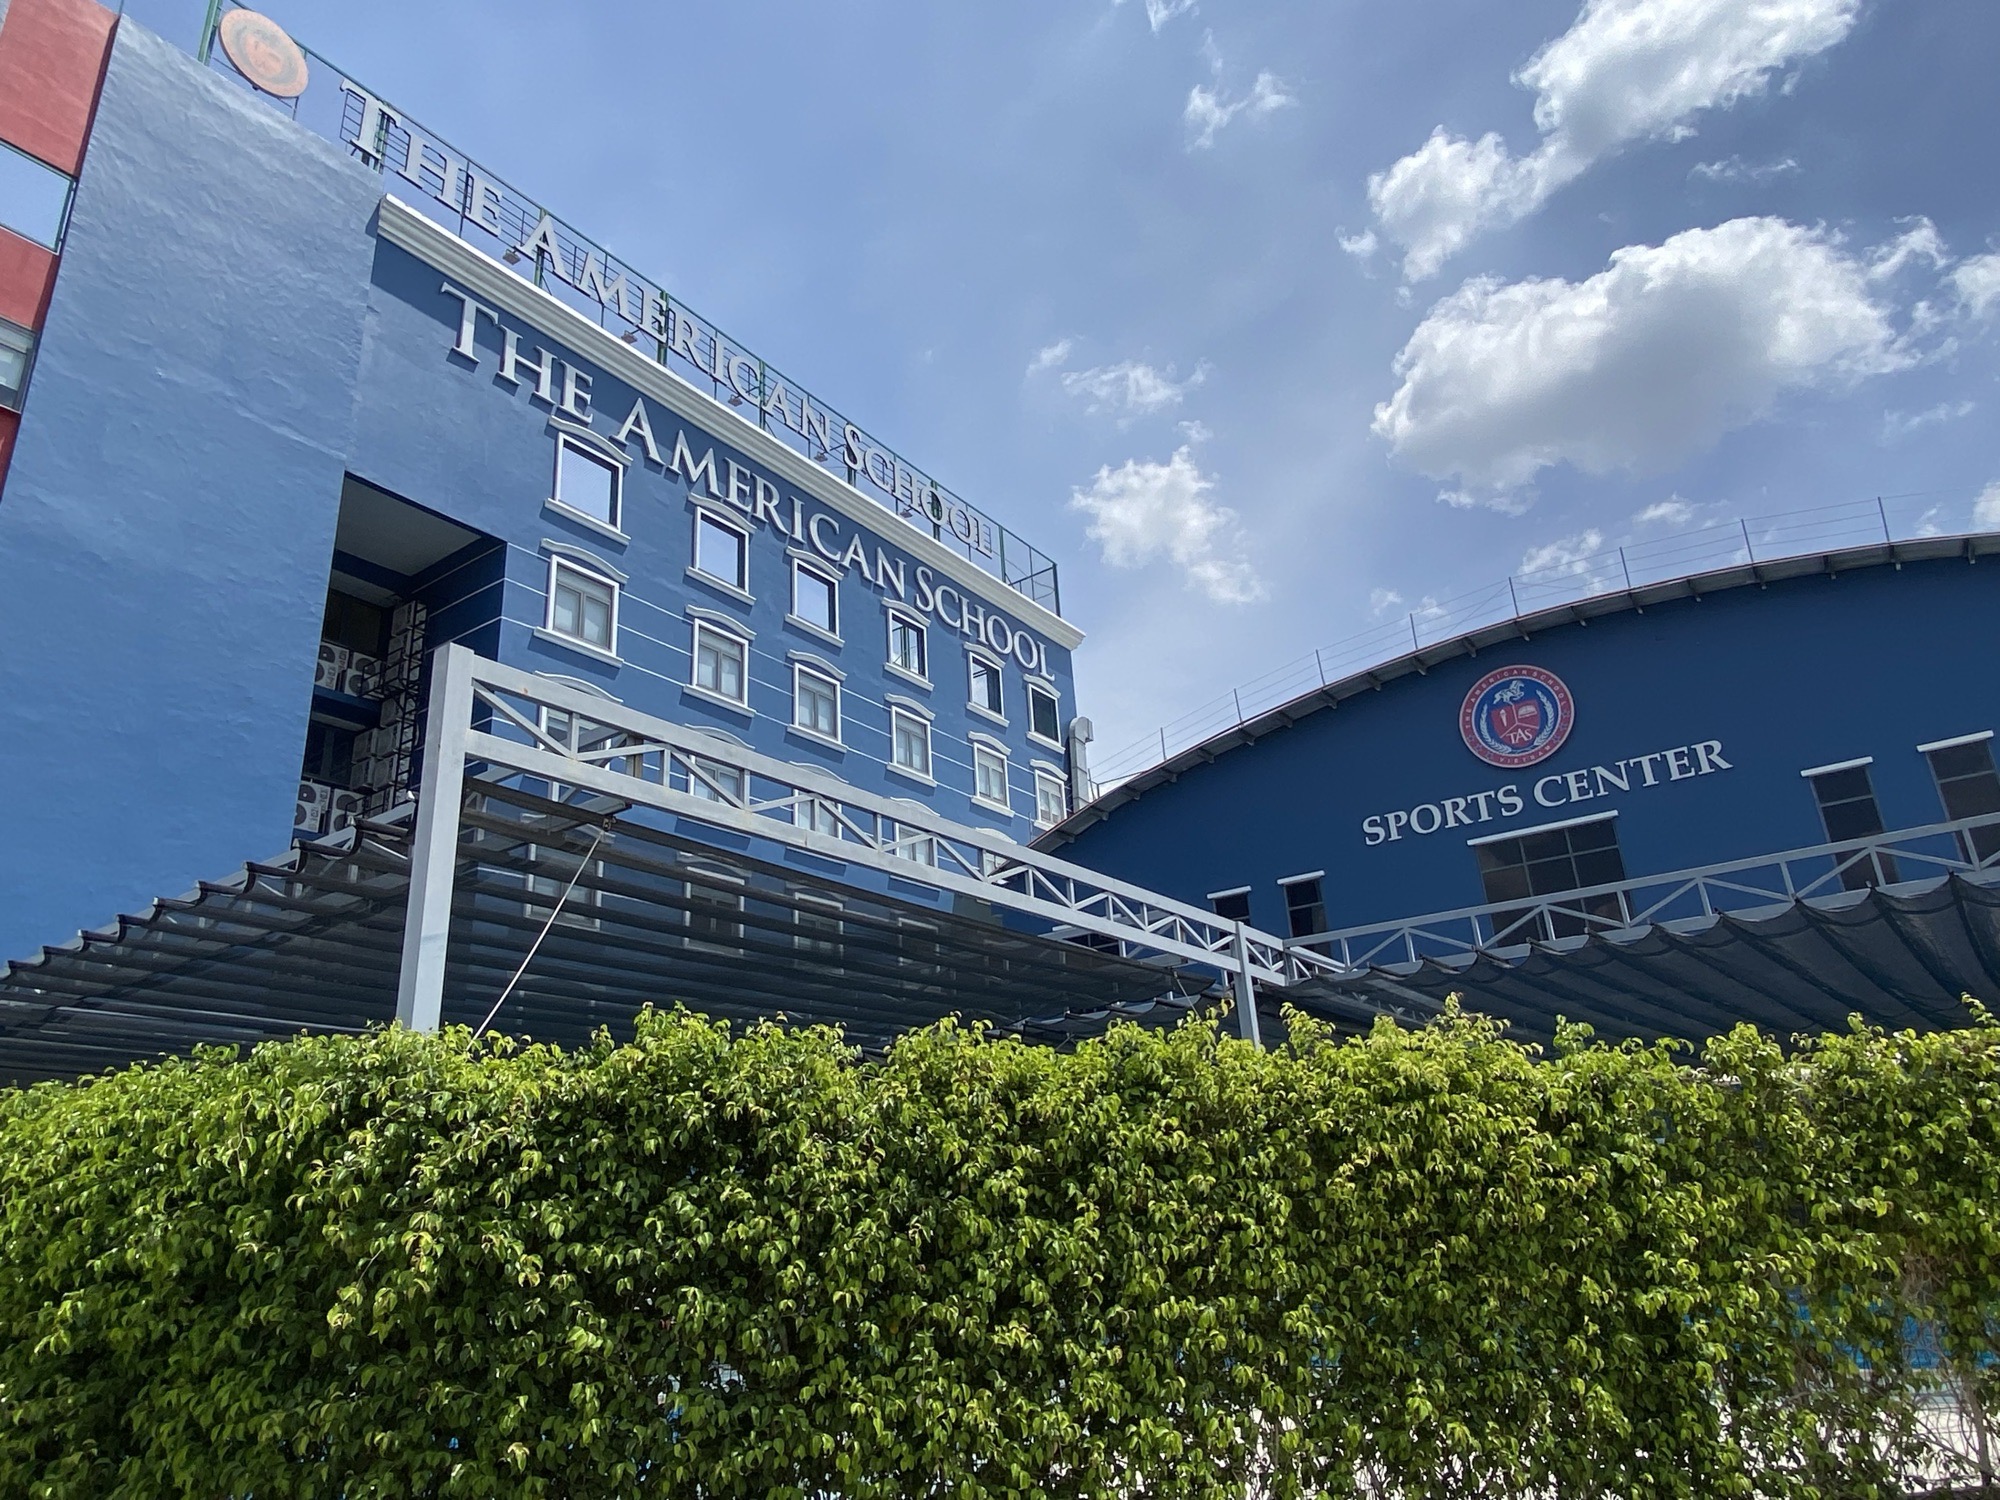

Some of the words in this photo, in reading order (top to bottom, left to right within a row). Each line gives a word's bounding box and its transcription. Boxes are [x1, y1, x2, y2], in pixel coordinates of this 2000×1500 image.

[340, 79, 501, 237] THE
[513, 214, 831, 454] AMERICAN
[842, 423, 993, 559] SCHOOL
[441, 281, 594, 425] THE
[611, 397, 906, 599] AMERICAN
[915, 566, 1056, 682] SCHOOL
[1470, 669, 1528, 703] AMERICAN
[1532, 671, 1566, 706] SCHOOL
[1496, 744, 1551, 764] VIETNAM
[1507, 728, 1532, 744] TAS
[1362, 785, 1524, 846] SPORTS
[1533, 740, 1733, 807] CENTER
